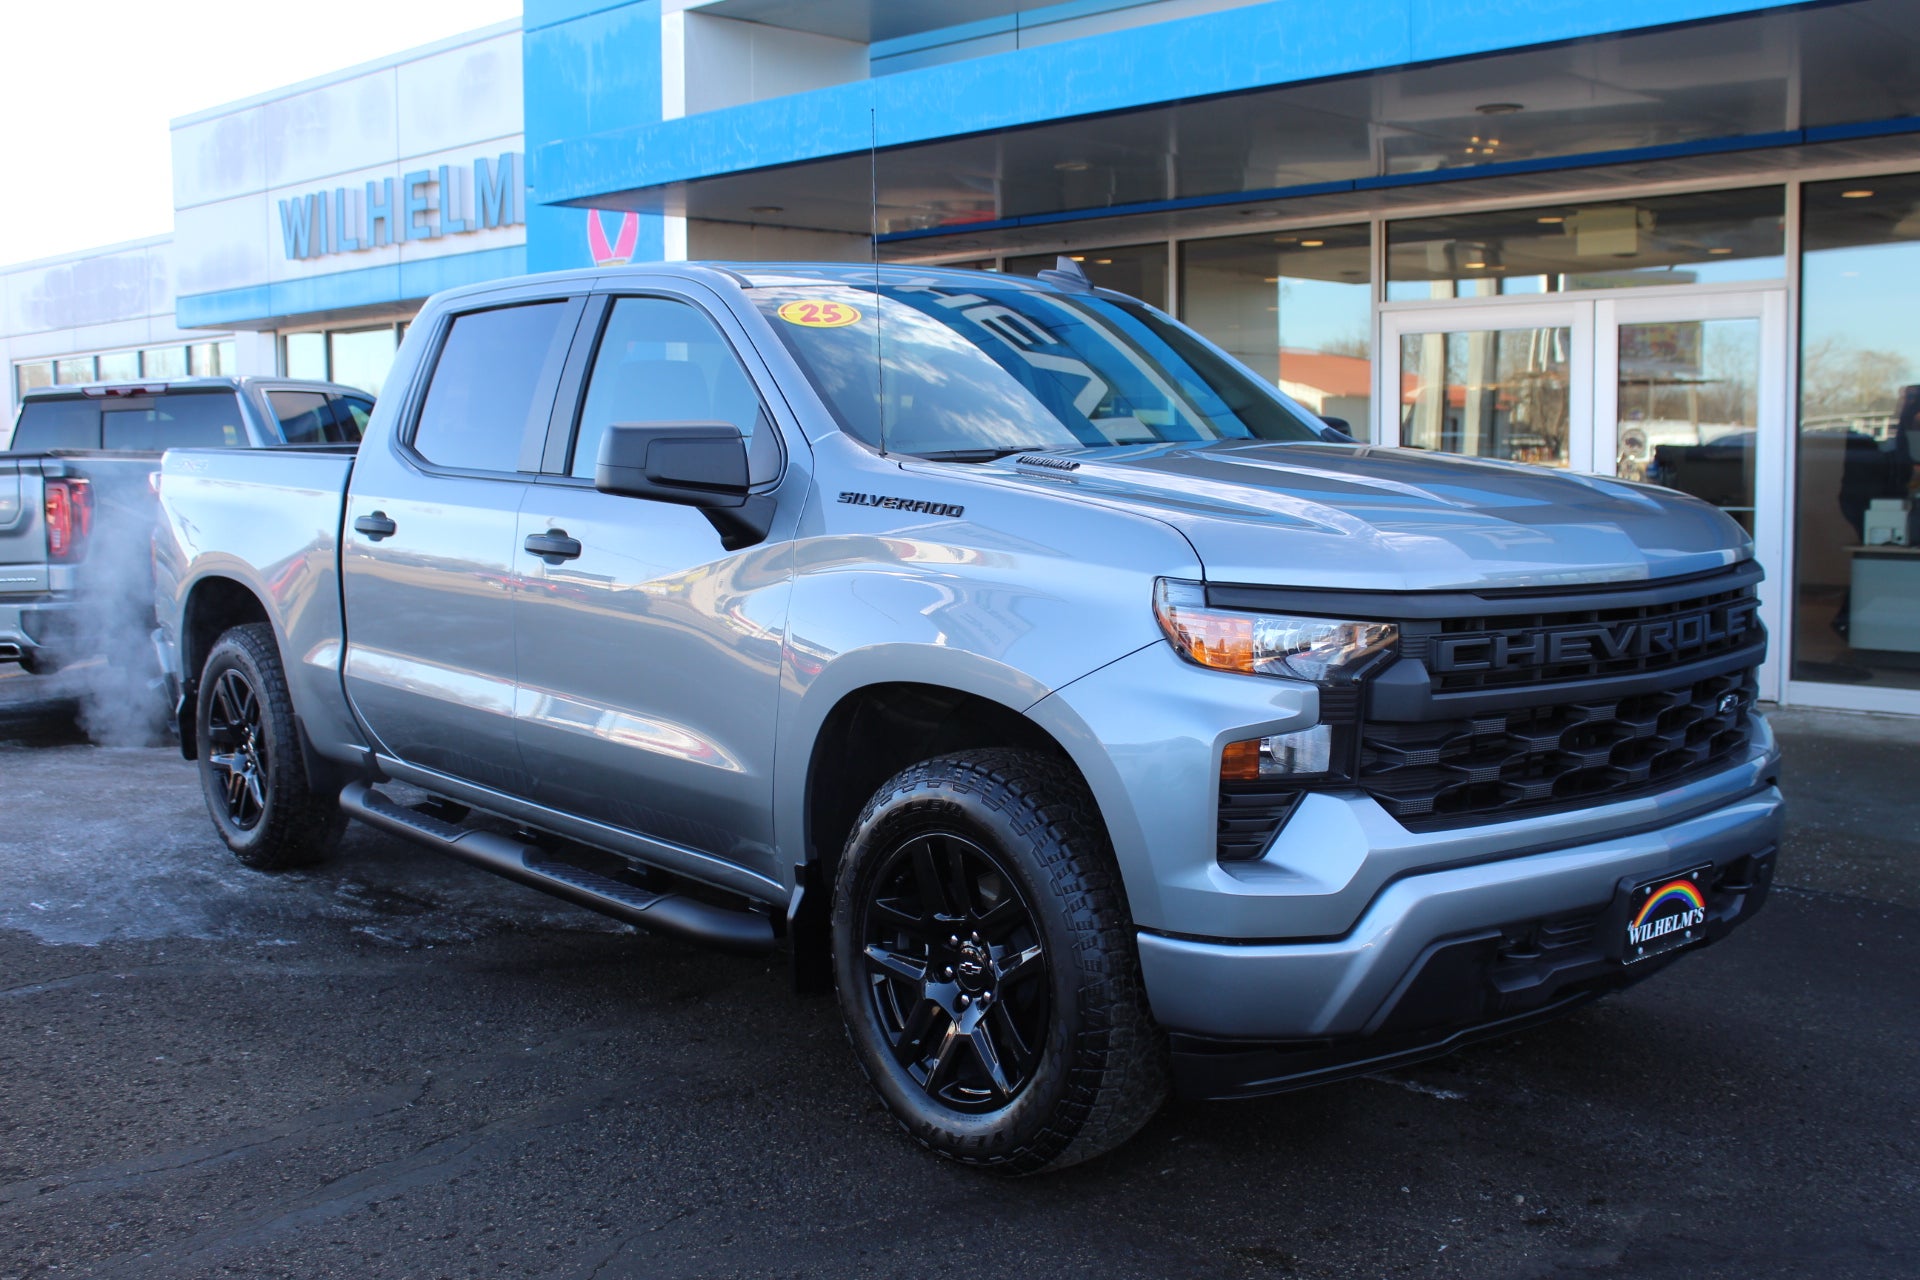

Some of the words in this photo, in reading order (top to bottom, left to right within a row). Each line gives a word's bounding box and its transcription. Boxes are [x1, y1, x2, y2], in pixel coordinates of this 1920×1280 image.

[278, 151, 517, 260] WILHELM
[798, 303, 842, 323] 25
[1016, 456, 1080, 471] TURBOMAX
[837, 491, 965, 518] SILVERADO
[1628, 906, 1705, 945] WILHELM'S
